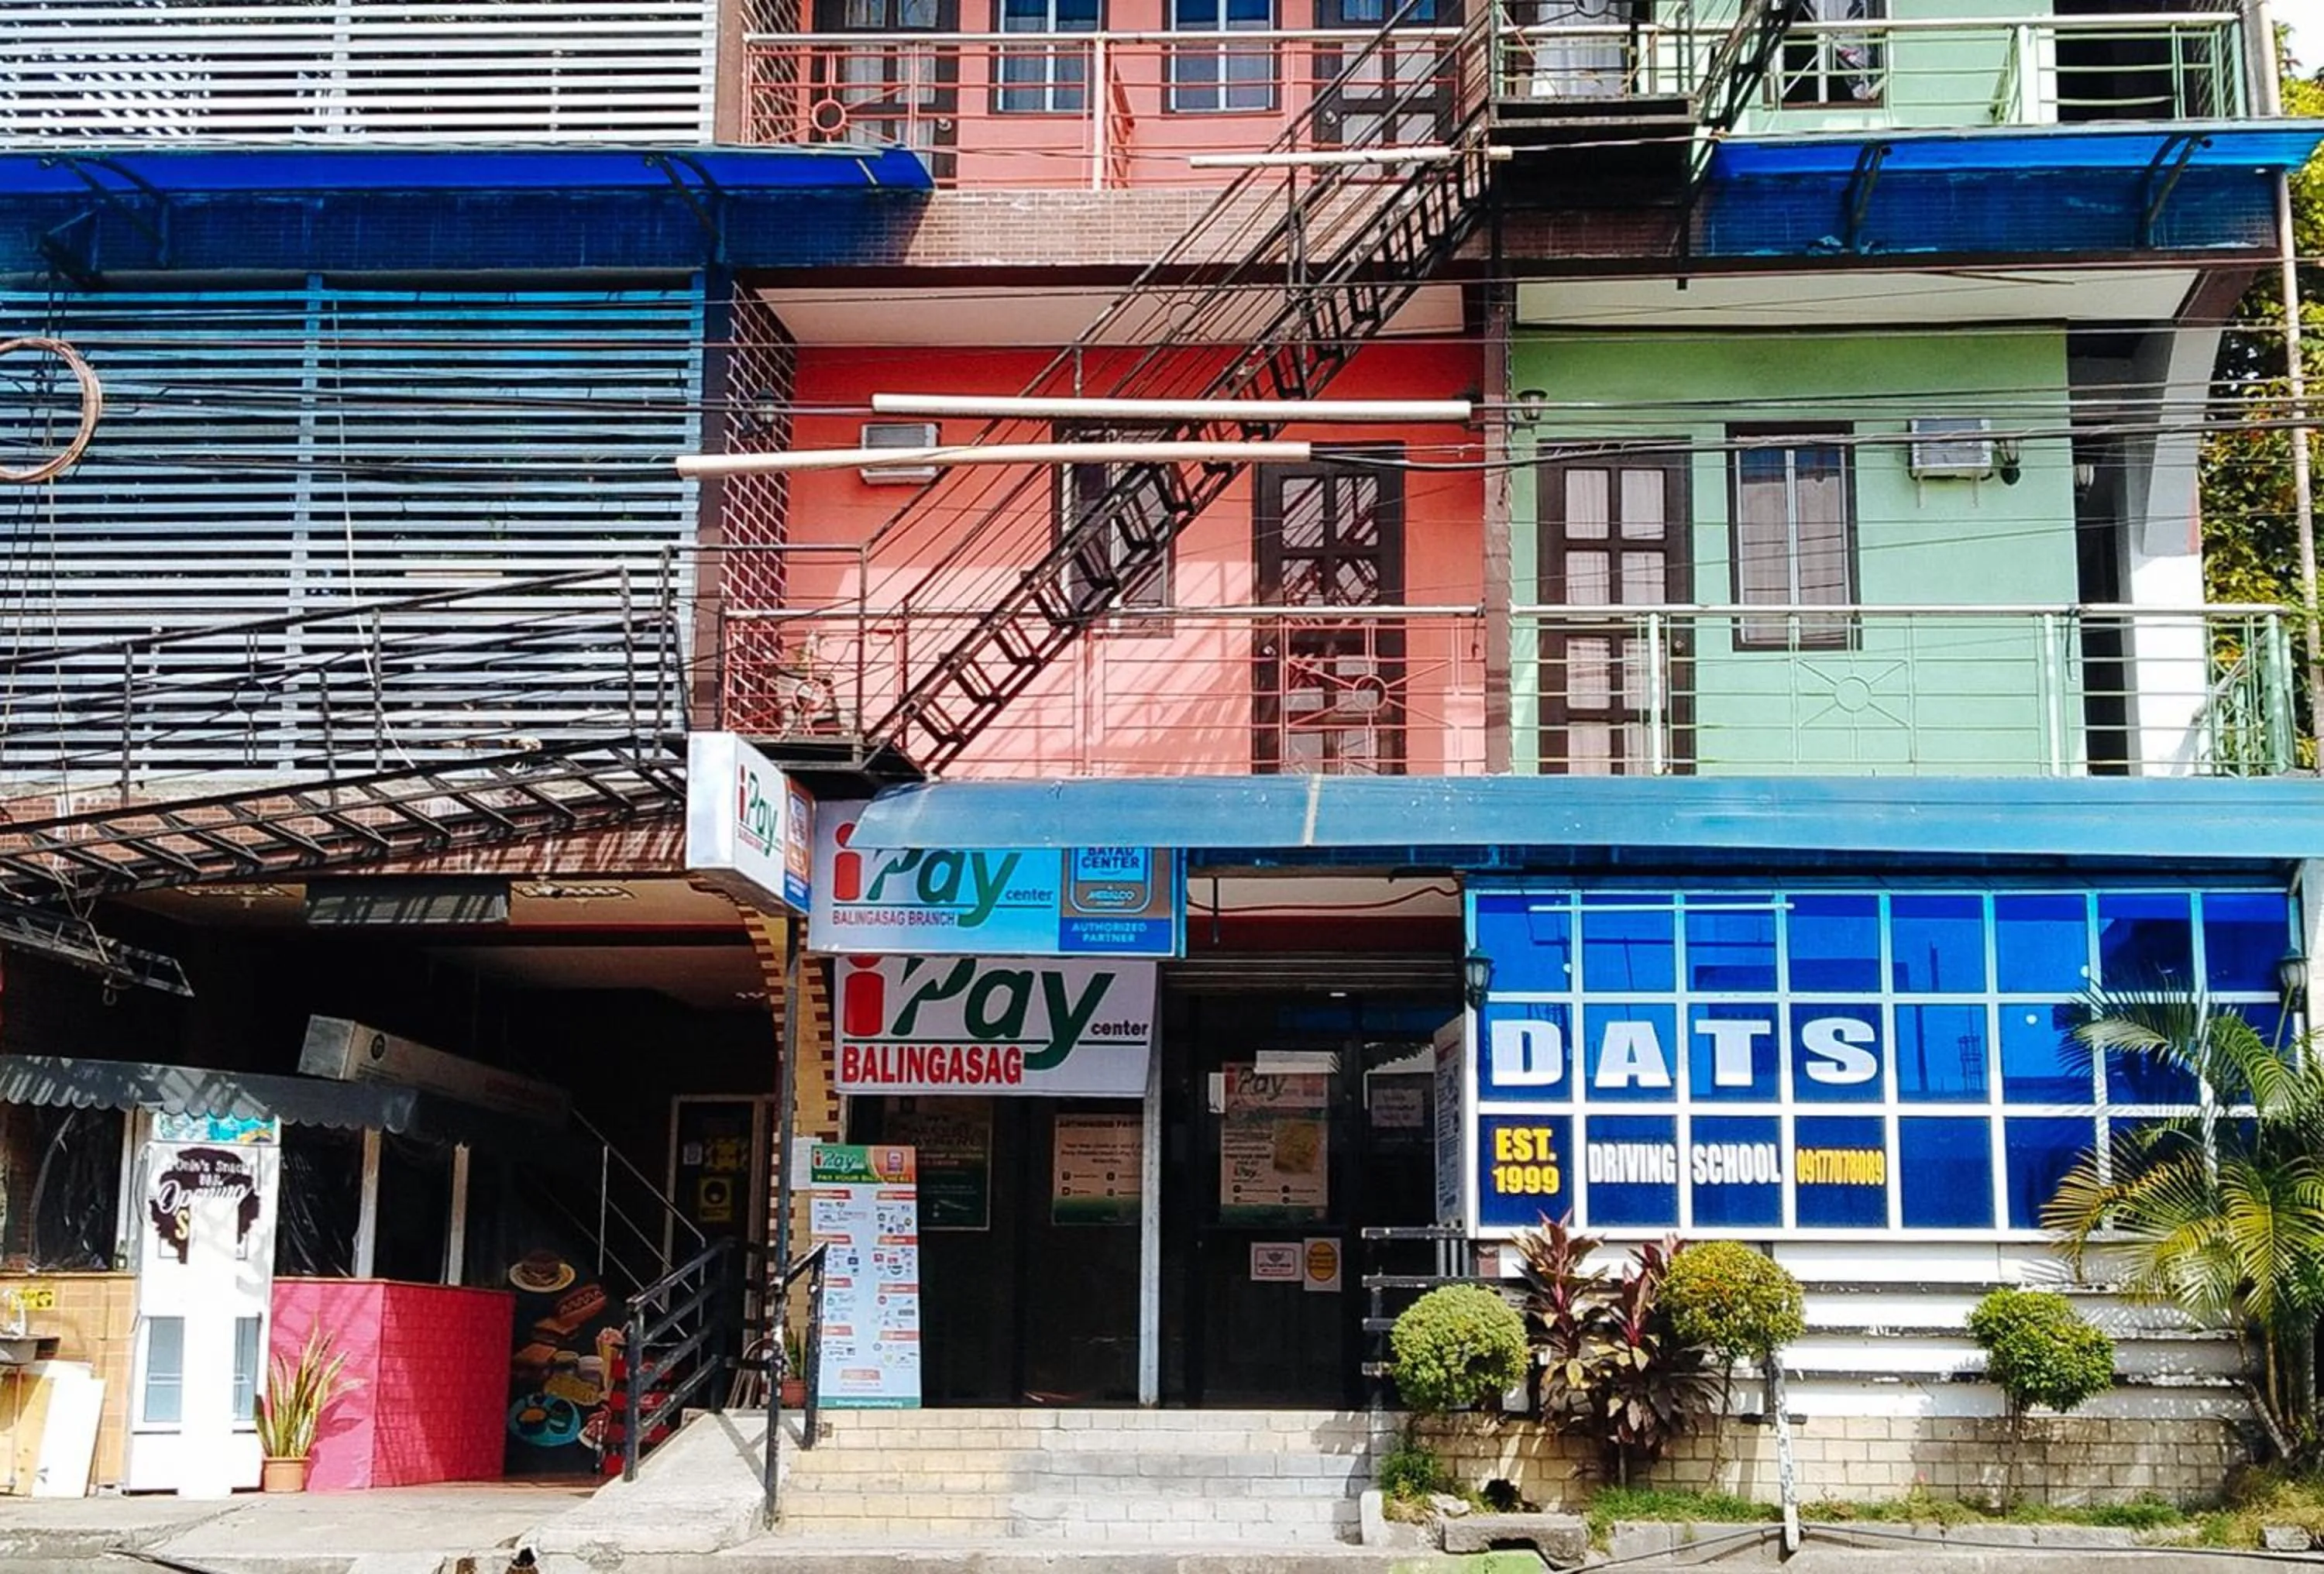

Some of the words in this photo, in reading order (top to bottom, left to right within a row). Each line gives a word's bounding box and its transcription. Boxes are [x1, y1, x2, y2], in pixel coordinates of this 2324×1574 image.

[1081, 856, 1140, 868] CENTER
[1006, 888, 1054, 903] center
[832, 910, 906, 926] BALINGASAG
[908, 912, 955, 927] BRANCH
[1071, 922, 1148, 933] AUTHORIZED
[1081, 933, 1136, 943] PARTNER
[1091, 1020, 1148, 1037] center
[841, 1046, 1022, 1084] BALINGASAG
[1494, 1128, 1556, 1162] EST.
[1588, 1144, 1676, 1184] DRIVING
[1692, 1143, 1781, 1185] SCHOOL
[1796, 1149, 1886, 1185] 09177078089
[1492, 1167, 1559, 1195] 1999
